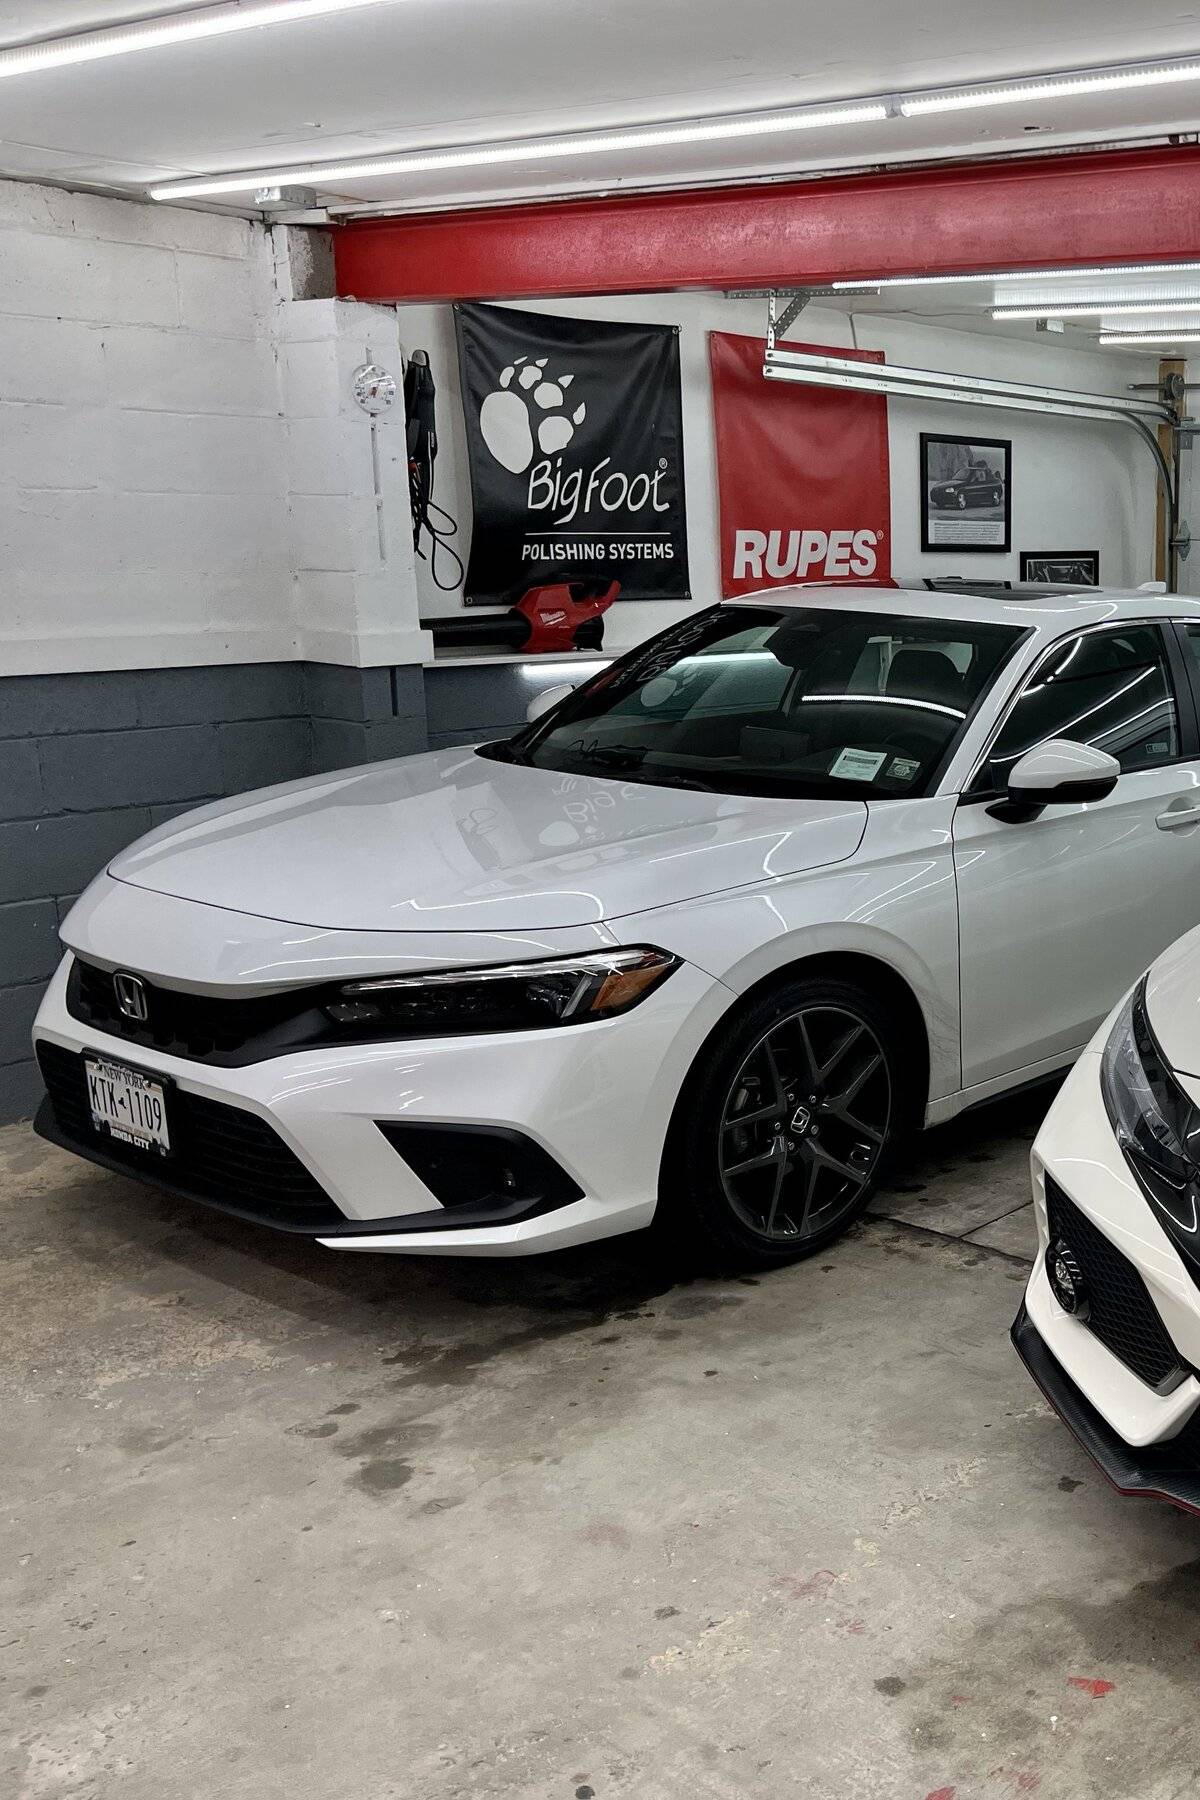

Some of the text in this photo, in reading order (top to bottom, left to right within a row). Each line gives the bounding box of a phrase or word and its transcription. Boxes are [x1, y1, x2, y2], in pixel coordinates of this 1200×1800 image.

[522, 543, 674, 560] POLISHING SYSTEMS
[733, 529, 878, 579] RUPES
[103, 1066, 146, 1091] NEW YORK
